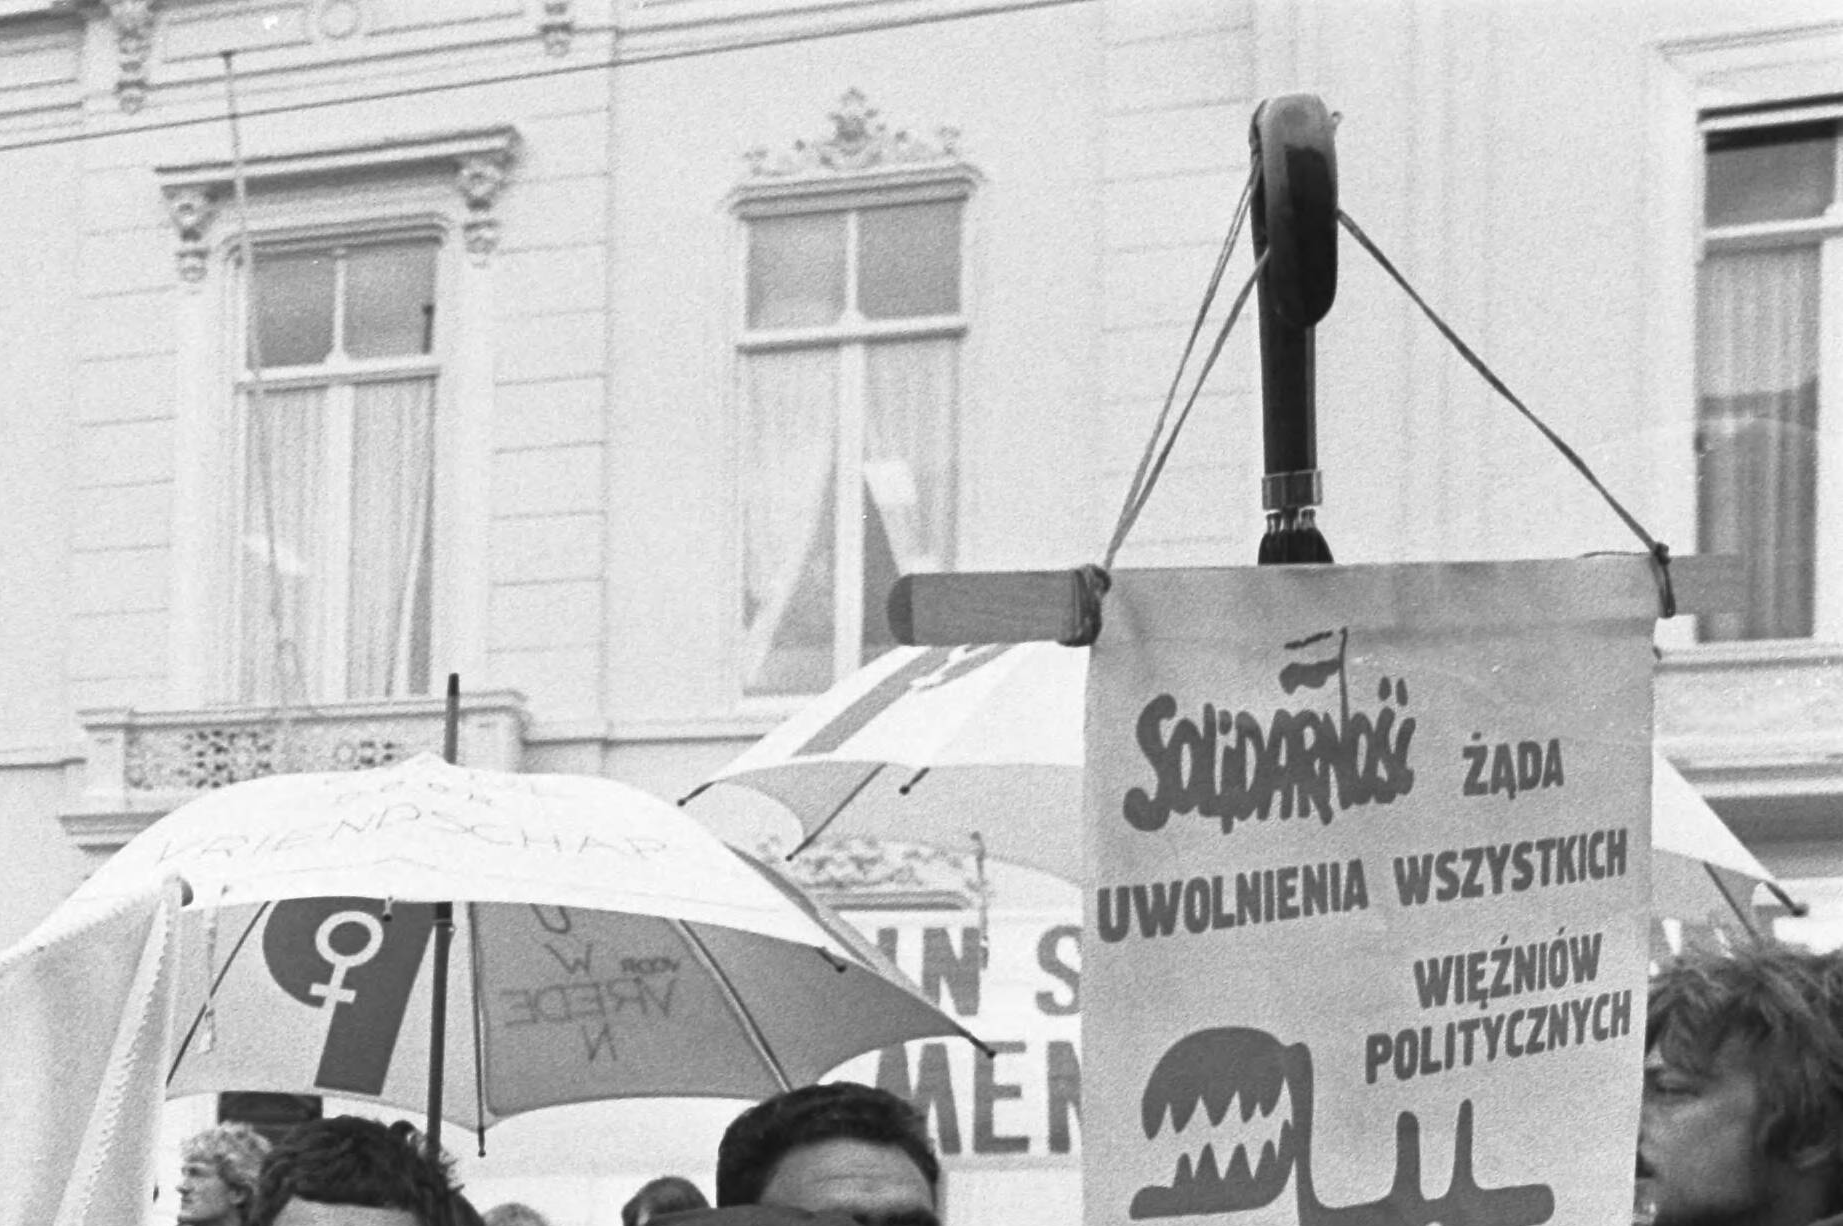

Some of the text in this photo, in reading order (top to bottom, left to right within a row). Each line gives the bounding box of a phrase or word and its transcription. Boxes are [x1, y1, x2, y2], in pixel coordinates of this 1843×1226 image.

[1462, 731, 1565, 799] ŻĄDA
[1095, 827, 1629, 944] UWOLNIENIA WSZYSTKICH
[1034, 924, 1082, 1017] S
[1413, 928, 1603, 1009] WIĘŹNIÓW
[1365, 989, 1633, 1085] POLITYCZNYCH
